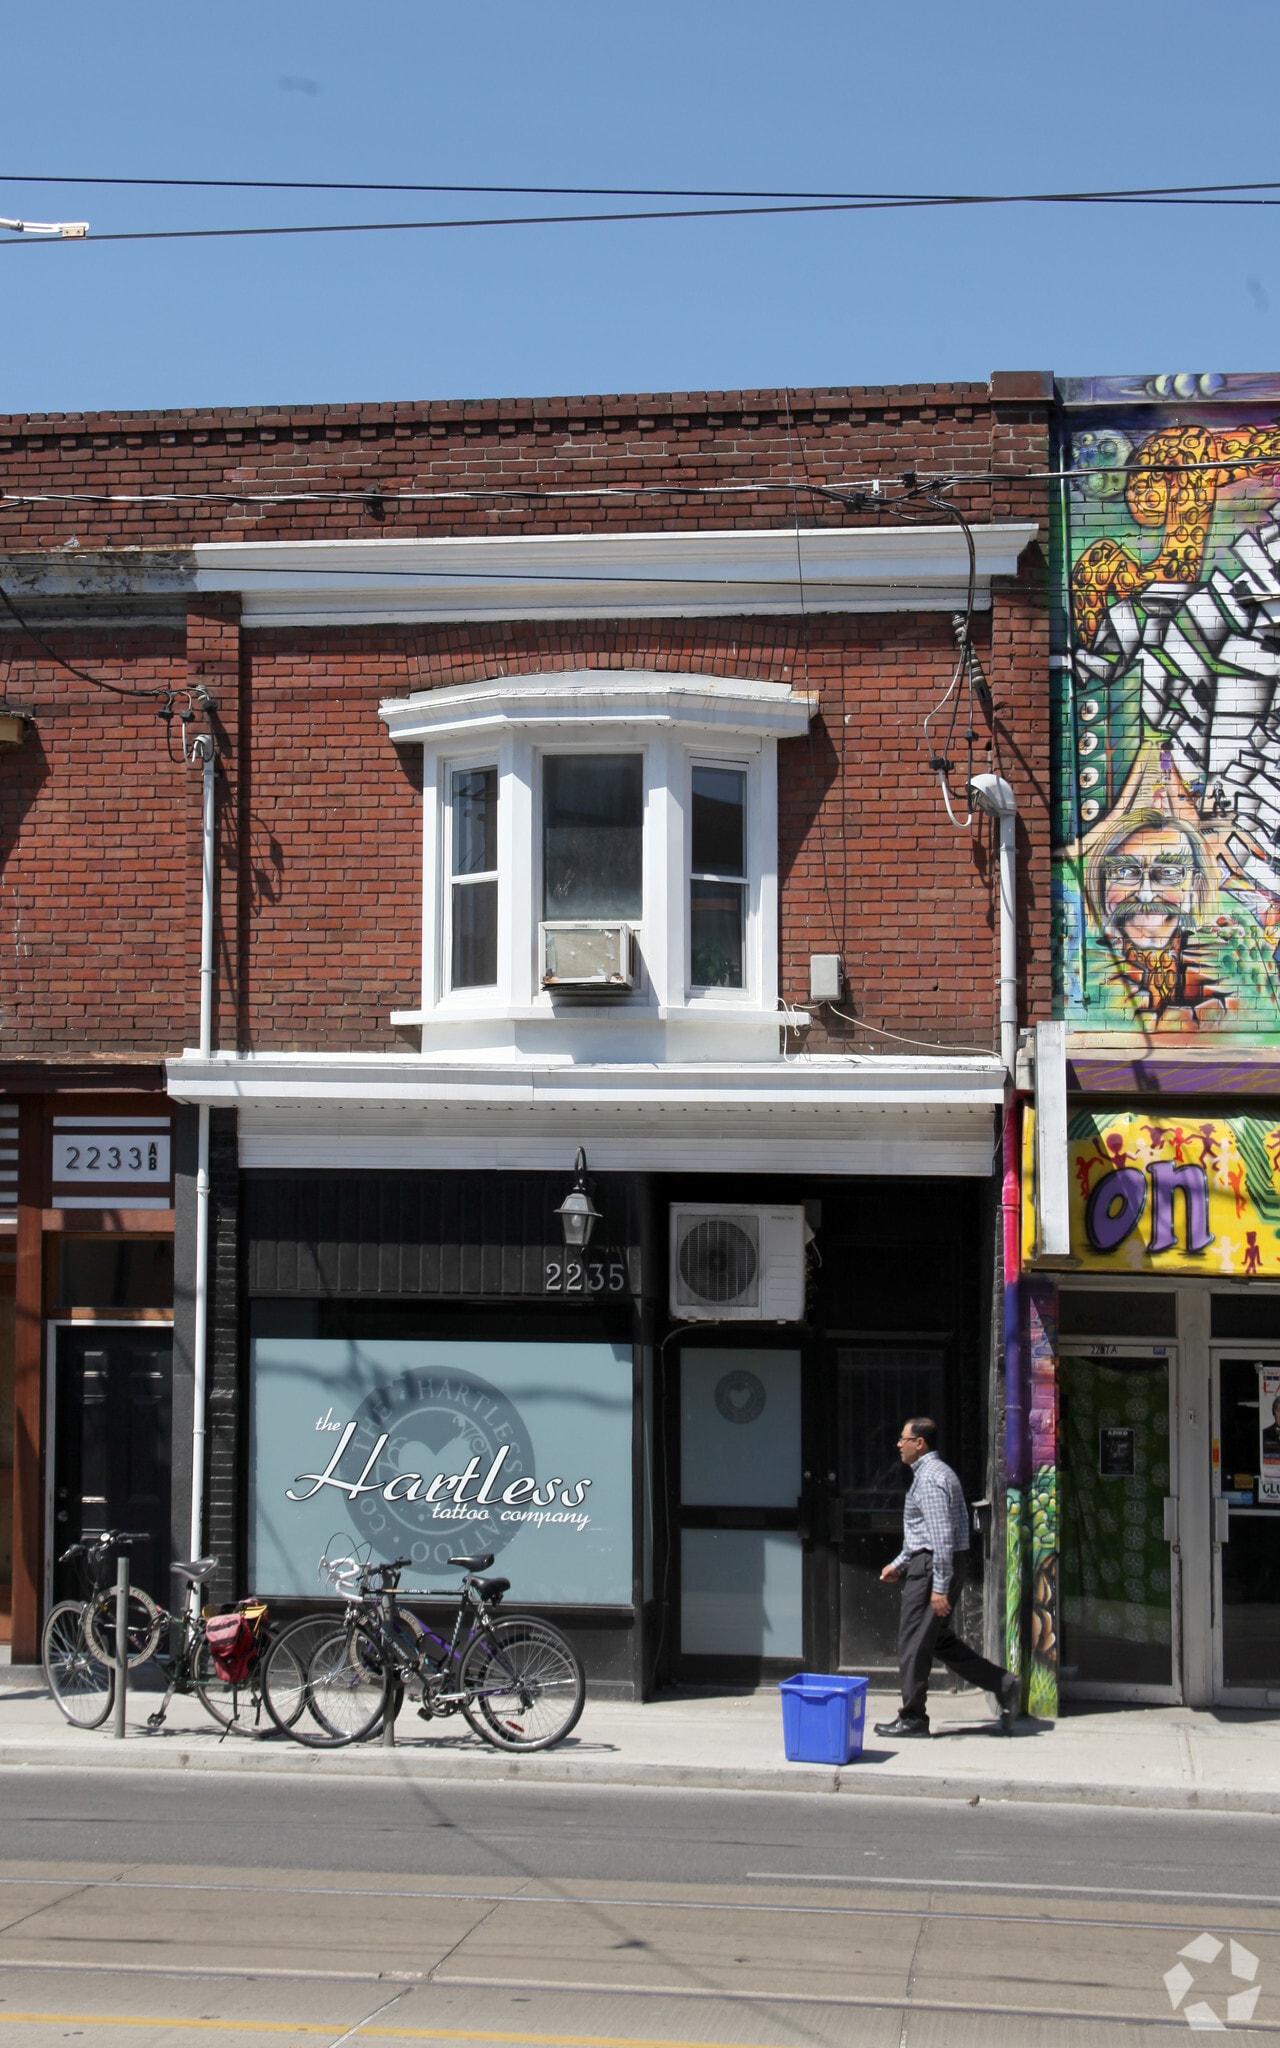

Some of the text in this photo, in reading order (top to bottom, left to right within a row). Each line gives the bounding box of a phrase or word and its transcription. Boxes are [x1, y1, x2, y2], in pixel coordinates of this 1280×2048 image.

[66, 1142, 157, 1170] 2233 A
[148, 1157, 157, 1171] B
[1085, 1160, 1215, 1253] on
[546, 1263, 625, 1291] 2235
[315, 1407, 342, 1432] the
[351, 1401, 393, 1451] THE
[417, 1377, 523, 1473] HARTLESS
[285, 1420, 593, 1507] Hartless
[432, 1502, 592, 1532] tattoo company
